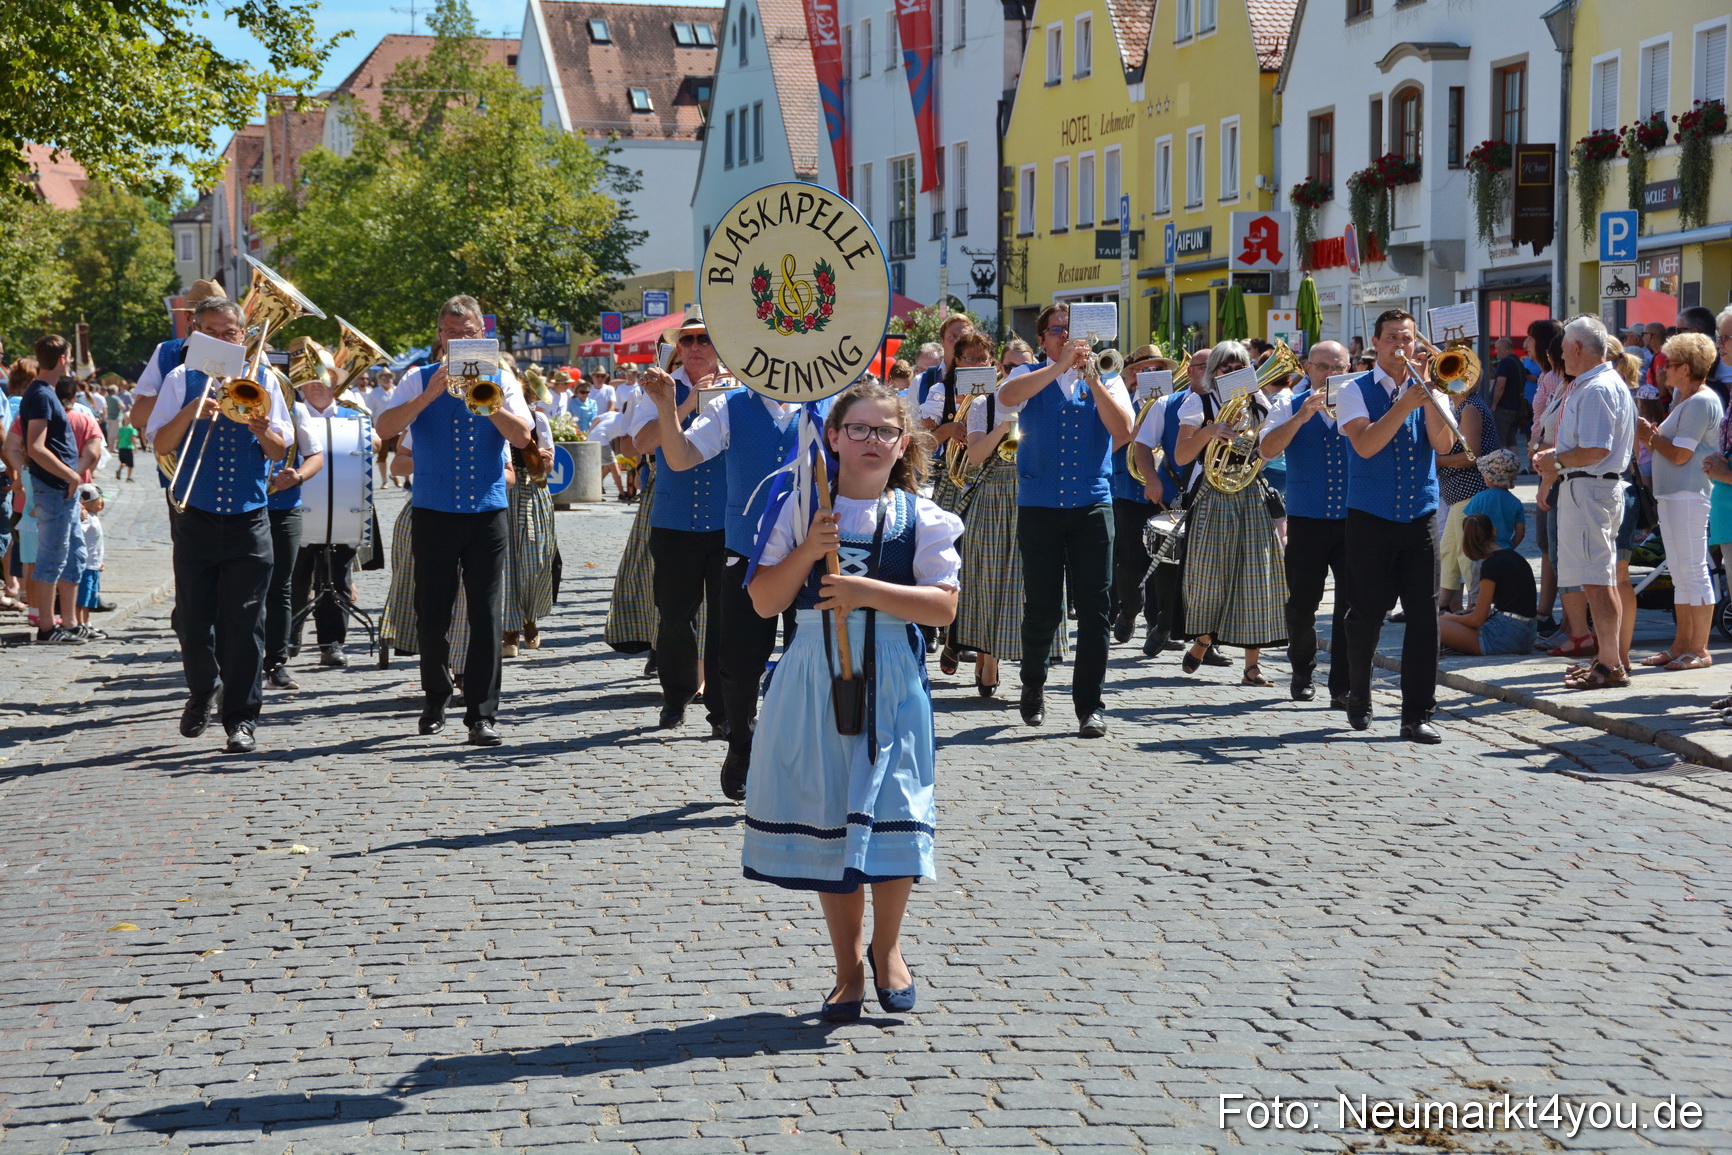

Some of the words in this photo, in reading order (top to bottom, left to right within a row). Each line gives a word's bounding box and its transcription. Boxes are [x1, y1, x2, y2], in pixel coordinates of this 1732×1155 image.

[1061, 114, 1092, 147] HOTEL
[1100, 108, 1136, 136] Lehmeier
[1644, 188, 1667, 205] WOLLE
[1122, 201, 1127, 231] P
[708, 190, 875, 286] BLASKAPELLE
[1167, 229, 1173, 259] P
[1608, 217, 1629, 256] P
[1098, 248, 1136, 256] TAIFN
[1058, 263, 1101, 284] Restaurant
[1611, 267, 1624, 275] nur
[603, 333, 620, 341] TAXI
[741, 335, 864, 394] DEINING
